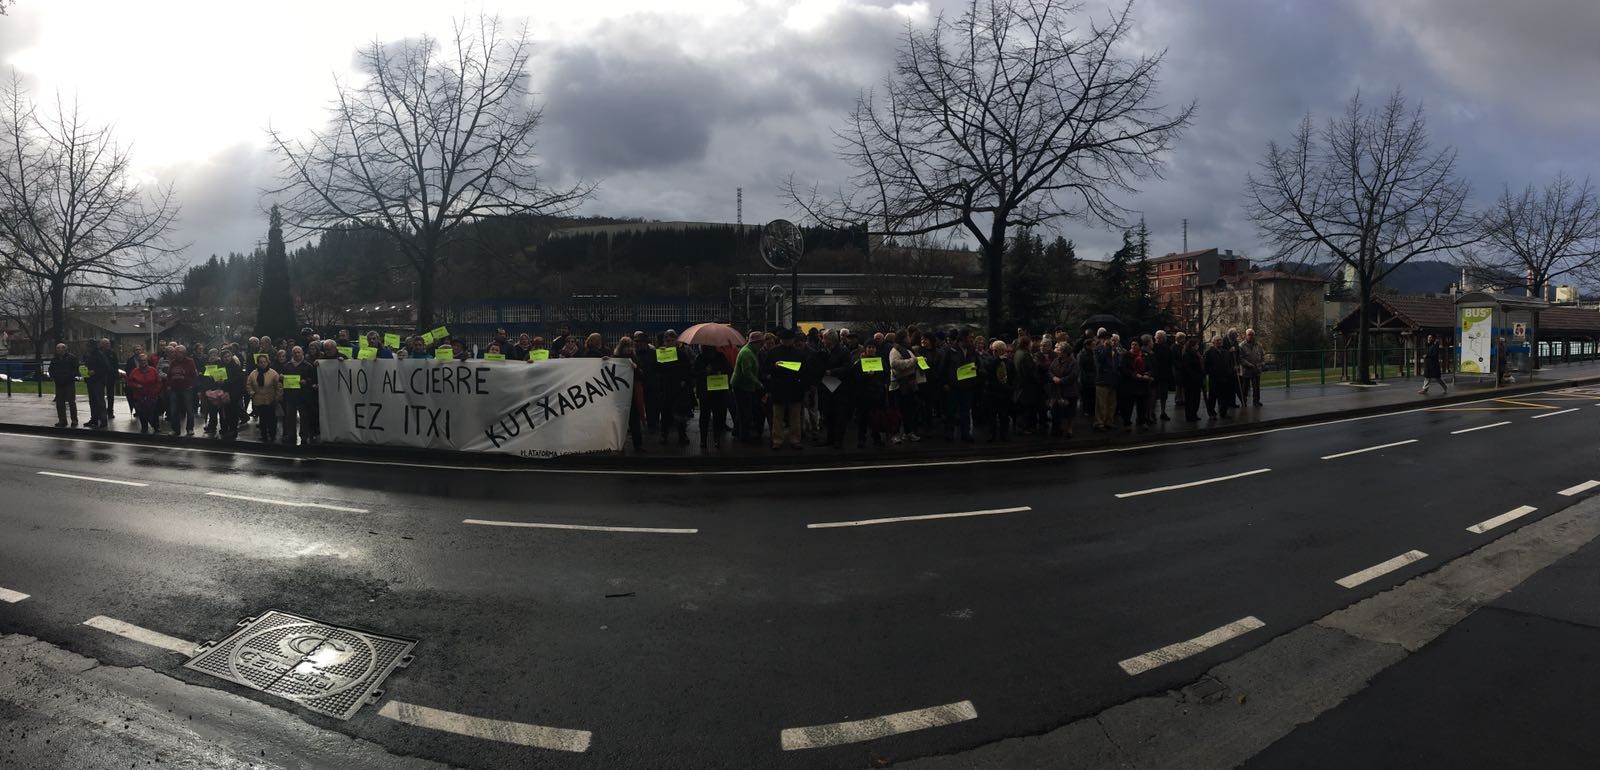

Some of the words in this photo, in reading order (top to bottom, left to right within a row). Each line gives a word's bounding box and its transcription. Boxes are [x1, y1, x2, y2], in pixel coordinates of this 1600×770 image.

[1465, 308, 1487, 318] BUS
[337, 368, 369, 395] NO
[382, 369, 405, 394] AL
[410, 366, 491, 396] CIERRE
[354, 403, 384, 431] EZ
[404, 404, 450, 440] ITXI
